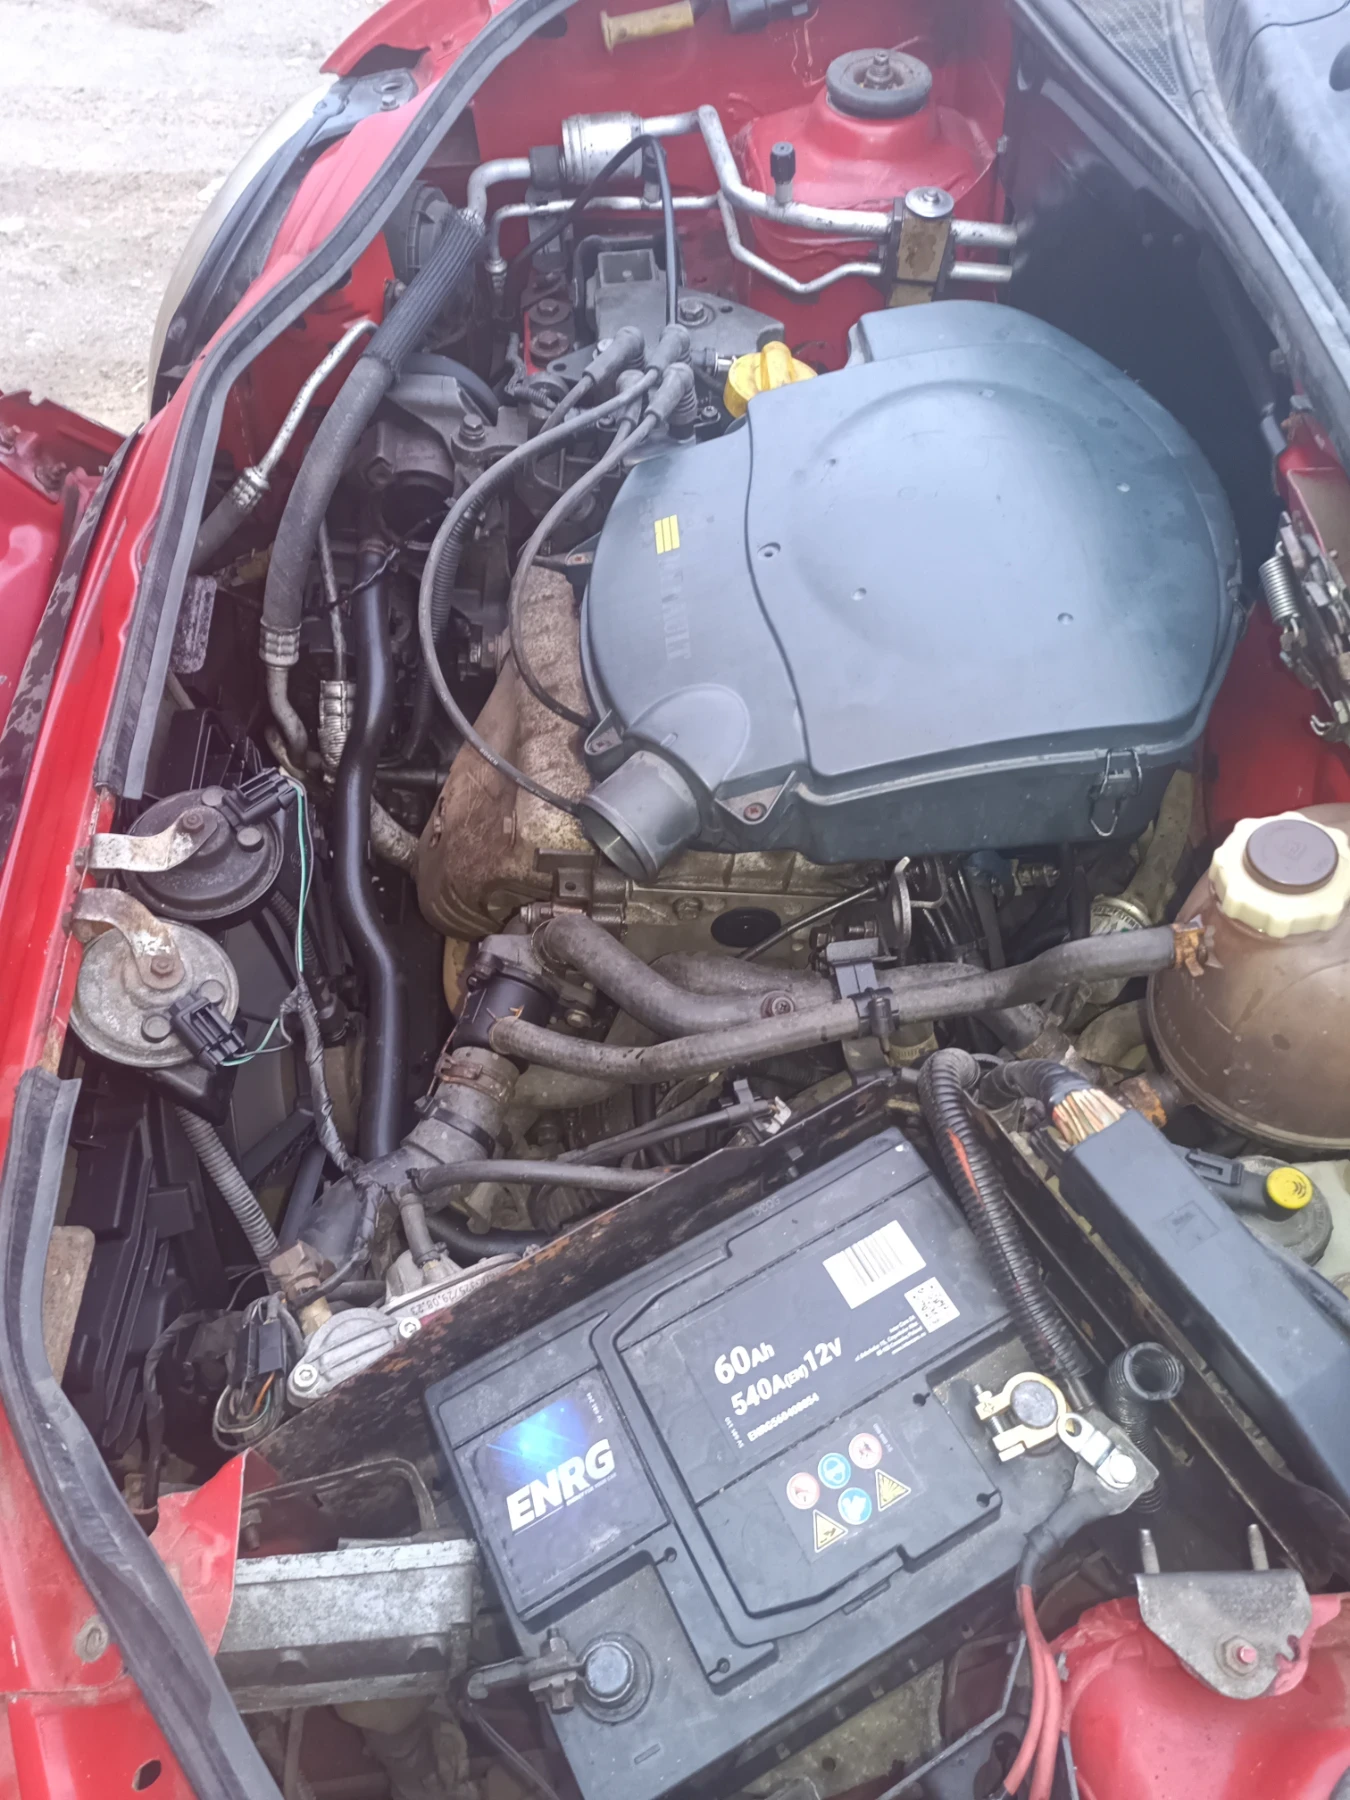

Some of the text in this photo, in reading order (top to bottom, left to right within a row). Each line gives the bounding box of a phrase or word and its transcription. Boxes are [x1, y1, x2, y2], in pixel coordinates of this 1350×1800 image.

[479, 748, 499, 766] BOSCH
[714, 1342, 775, 1385] 60Ah
[506, 1438, 616, 1532] ENRG
